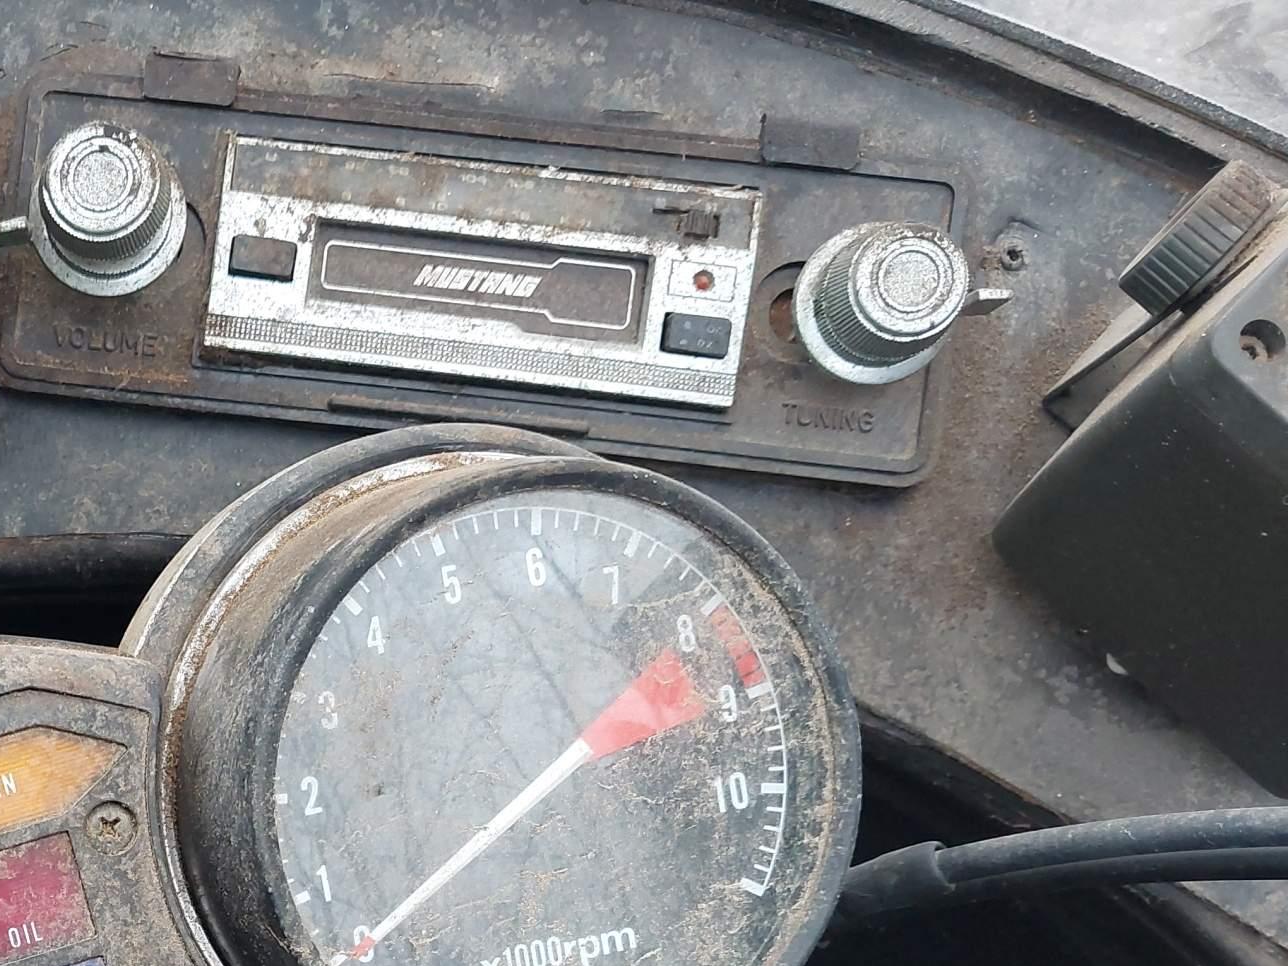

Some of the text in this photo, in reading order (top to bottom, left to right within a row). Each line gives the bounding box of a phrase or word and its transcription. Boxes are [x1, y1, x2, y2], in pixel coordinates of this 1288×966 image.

[413, 264, 543, 298] MUSTANG
[53, 325, 158, 357] VOLUME
[781, 403, 874, 433] TUNING
[440, 564, 462, 603] 5
[525, 547, 547, 587] 6
[602, 565, 619, 604] 7
[367, 615, 386, 654] 4
[677, 614, 696, 652] 8
[319, 691, 339, 729] 3
[720, 684, 737, 723] 9
[301, 775, 323, 816] 2
[713, 772, 749, 813] 10
[316, 865, 332, 902] 1
[8, 921, 44, 949] OIL
